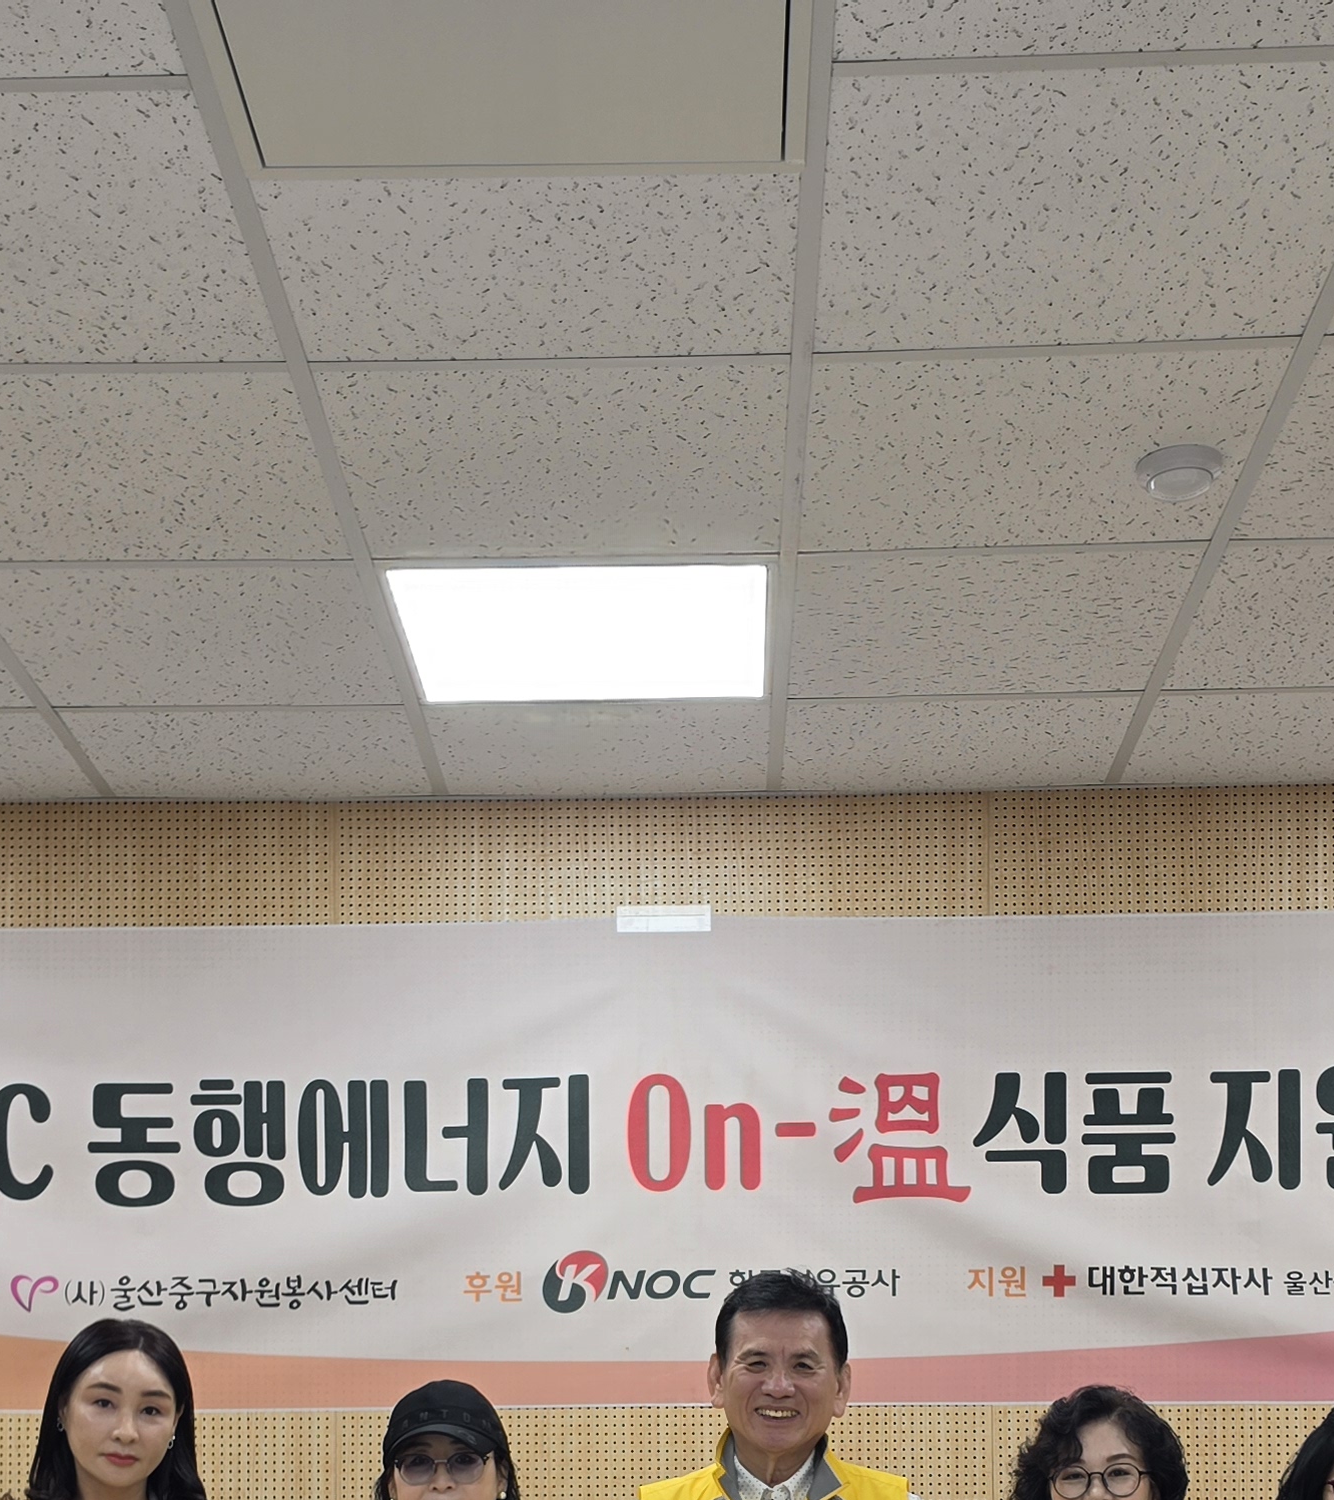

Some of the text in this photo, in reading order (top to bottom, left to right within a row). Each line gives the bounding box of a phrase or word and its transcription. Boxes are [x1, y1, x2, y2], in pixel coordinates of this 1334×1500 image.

[87, 1073, 591, 1209] 동행에너지
[972, 1071, 1177, 1196] 식품
[64, 1276, 398, 1312] (사)울산중구자원봉사센터
[463, 1271, 524, 1304] 후원
[542, 1250, 717, 1314] KNOC
[967, 1266, 1028, 1299] 지원
[1087, 1264, 1274, 1297] 대한적십자사
